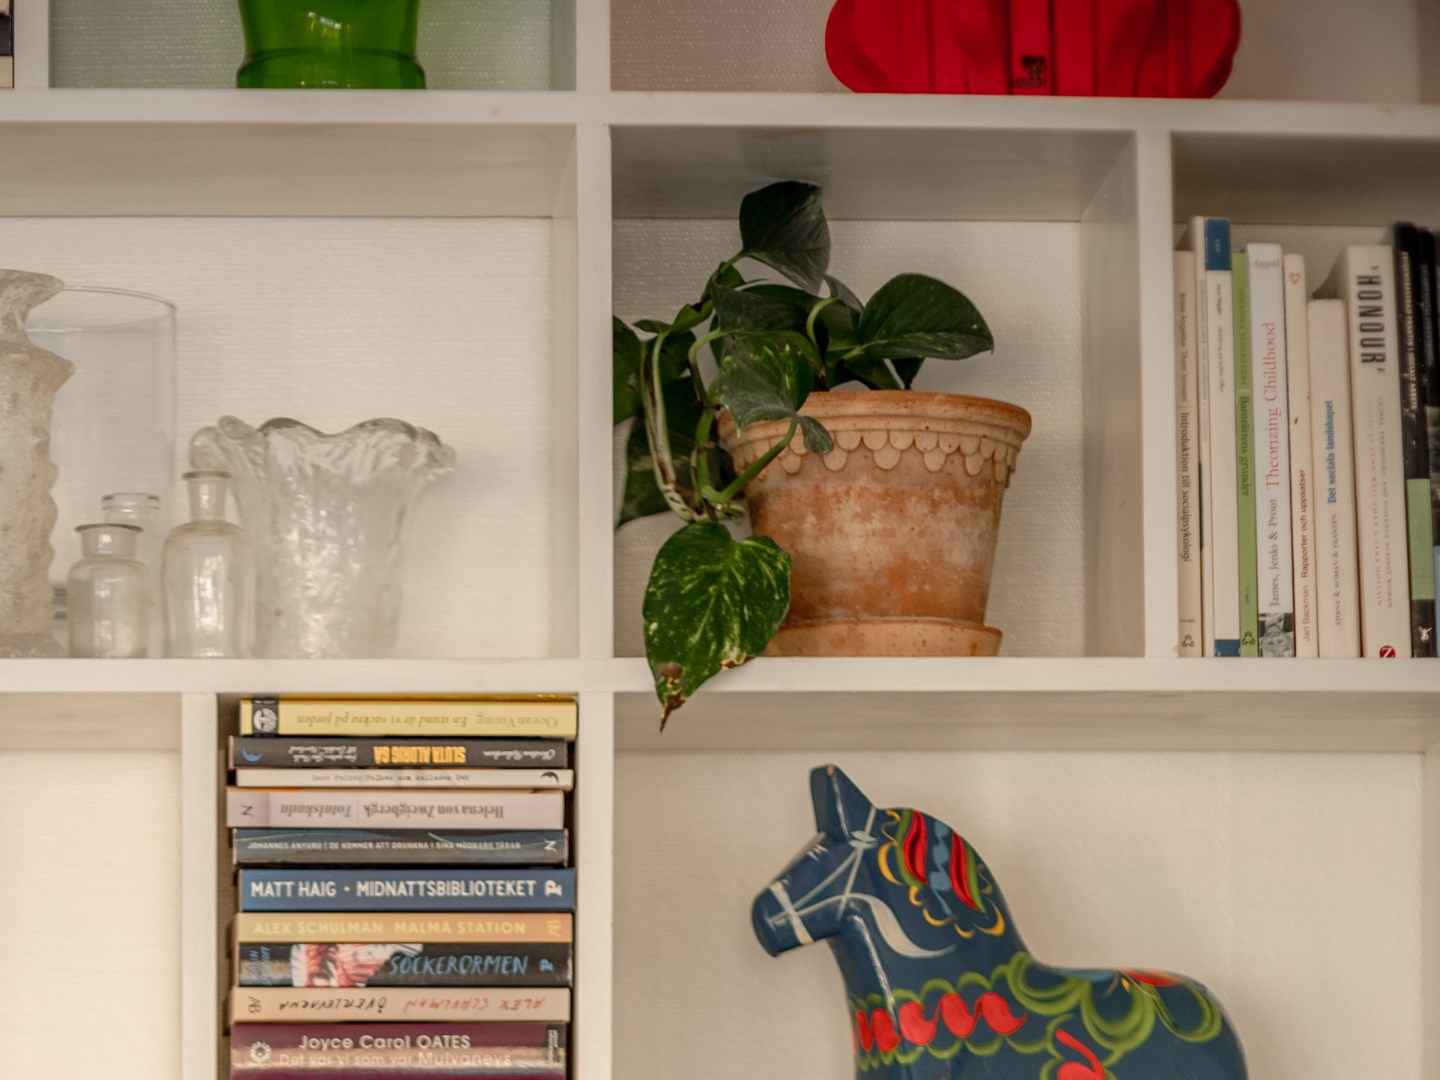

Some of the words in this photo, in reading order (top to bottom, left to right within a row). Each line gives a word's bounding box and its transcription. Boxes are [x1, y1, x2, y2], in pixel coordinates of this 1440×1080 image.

[1262, 323, 1279, 402] Childhood
[1324, 400, 1336, 450] landskapet
[1179, 412, 1191, 473] Introduktion
[1265, 408, 1282, 489] Theorizing
[1325, 453, 1336, 485] sociala
[1181, 475, 1191, 489] till
[1327, 487, 1337, 503] Det
[1298, 515, 1307, 532] och
[418, 716, 450, 727] stund
[453, 716, 467, 727] En
[517, 717, 558, 727] Ocean
[373, 746, 388, 765] GÅ
[391, 746, 431, 763] ALDRIG
[432, 746, 466, 763] SLUTA
[281, 804, 352, 816] Totalskada
[436, 805, 459, 817] von
[461, 805, 504, 818] Helena
[251, 881, 295, 897] MATT
[299, 881, 337, 897] HAIG
[356, 879, 535, 897] MIDNATTSBIBLIOTEKET
[254, 921, 291, 935] ALEX
[297, 921, 383, 935] SCHULMAN
[395, 921, 452, 934] MALMA
[457, 921, 526, 934] STATION
[390, 953, 528, 976] SOCKERORMEN
[500, 997, 546, 1011] ALEX
[299, 1035, 354, 1050] Joyce
[360, 1035, 410, 1049] Carol
[416, 1035, 471, 1049] OATES
